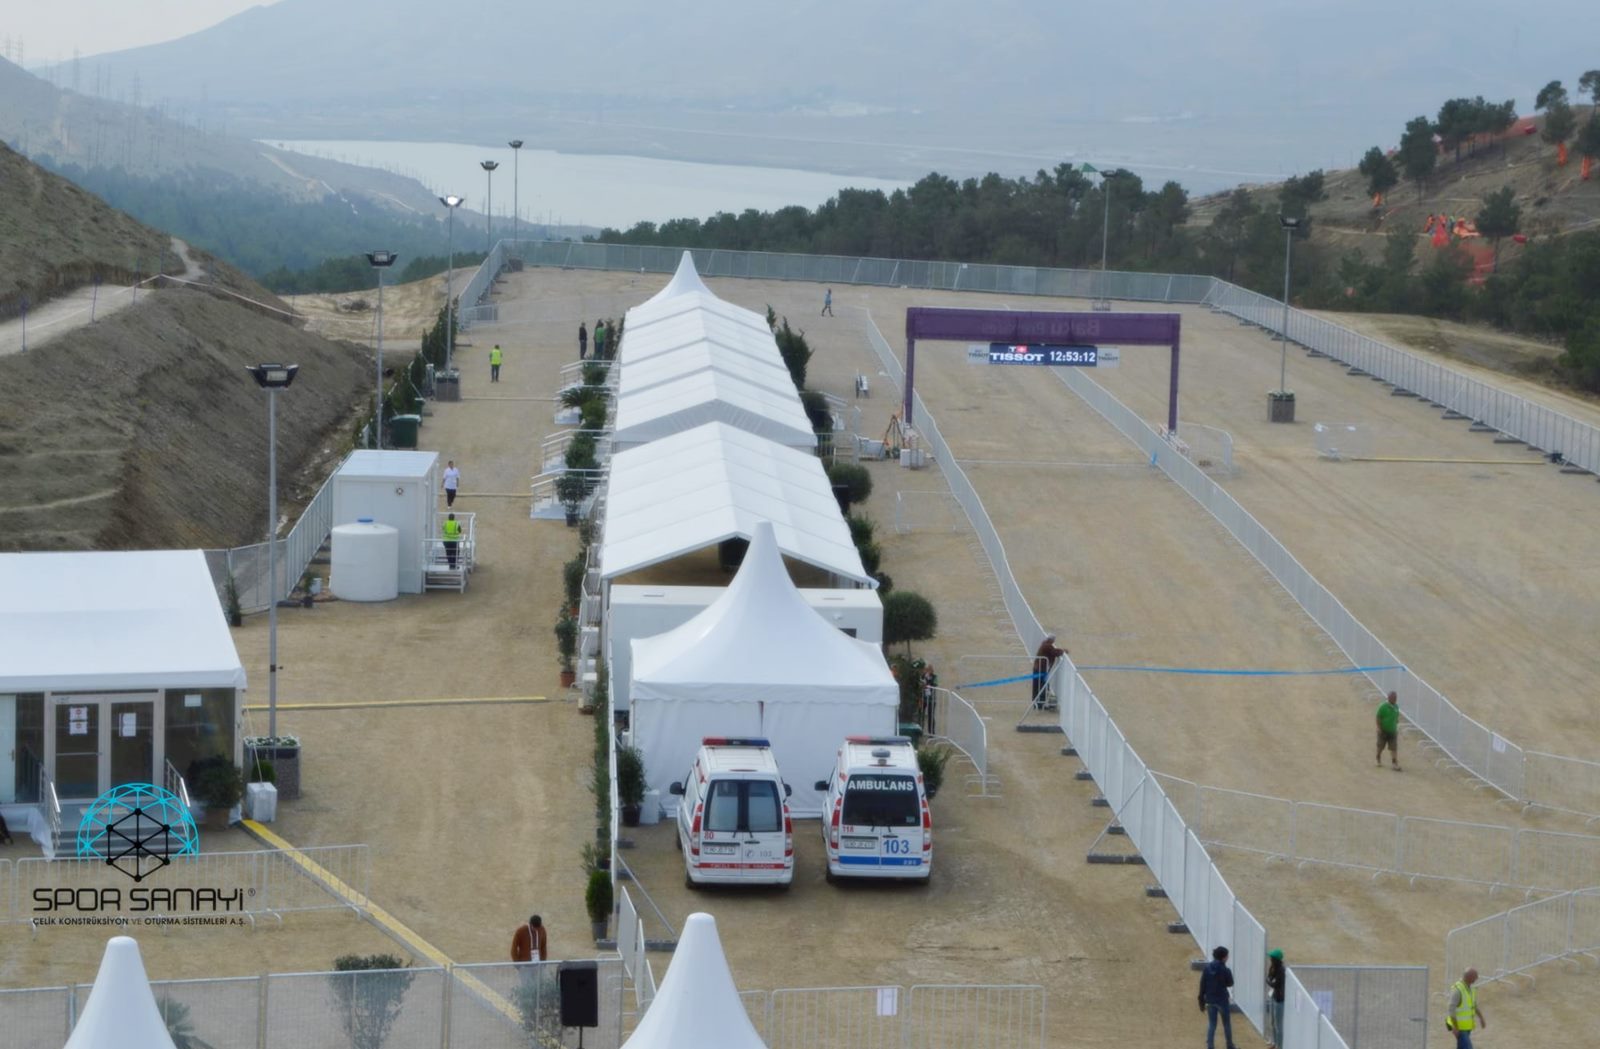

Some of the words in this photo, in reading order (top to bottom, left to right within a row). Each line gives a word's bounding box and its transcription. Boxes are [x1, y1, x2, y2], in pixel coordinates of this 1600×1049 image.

[990, 352, 1045, 362] TISSOT
[1050, 351, 1096, 363] 12:53:12
[848, 780, 914, 791] AMBULANS
[883, 839, 910, 854] 103
